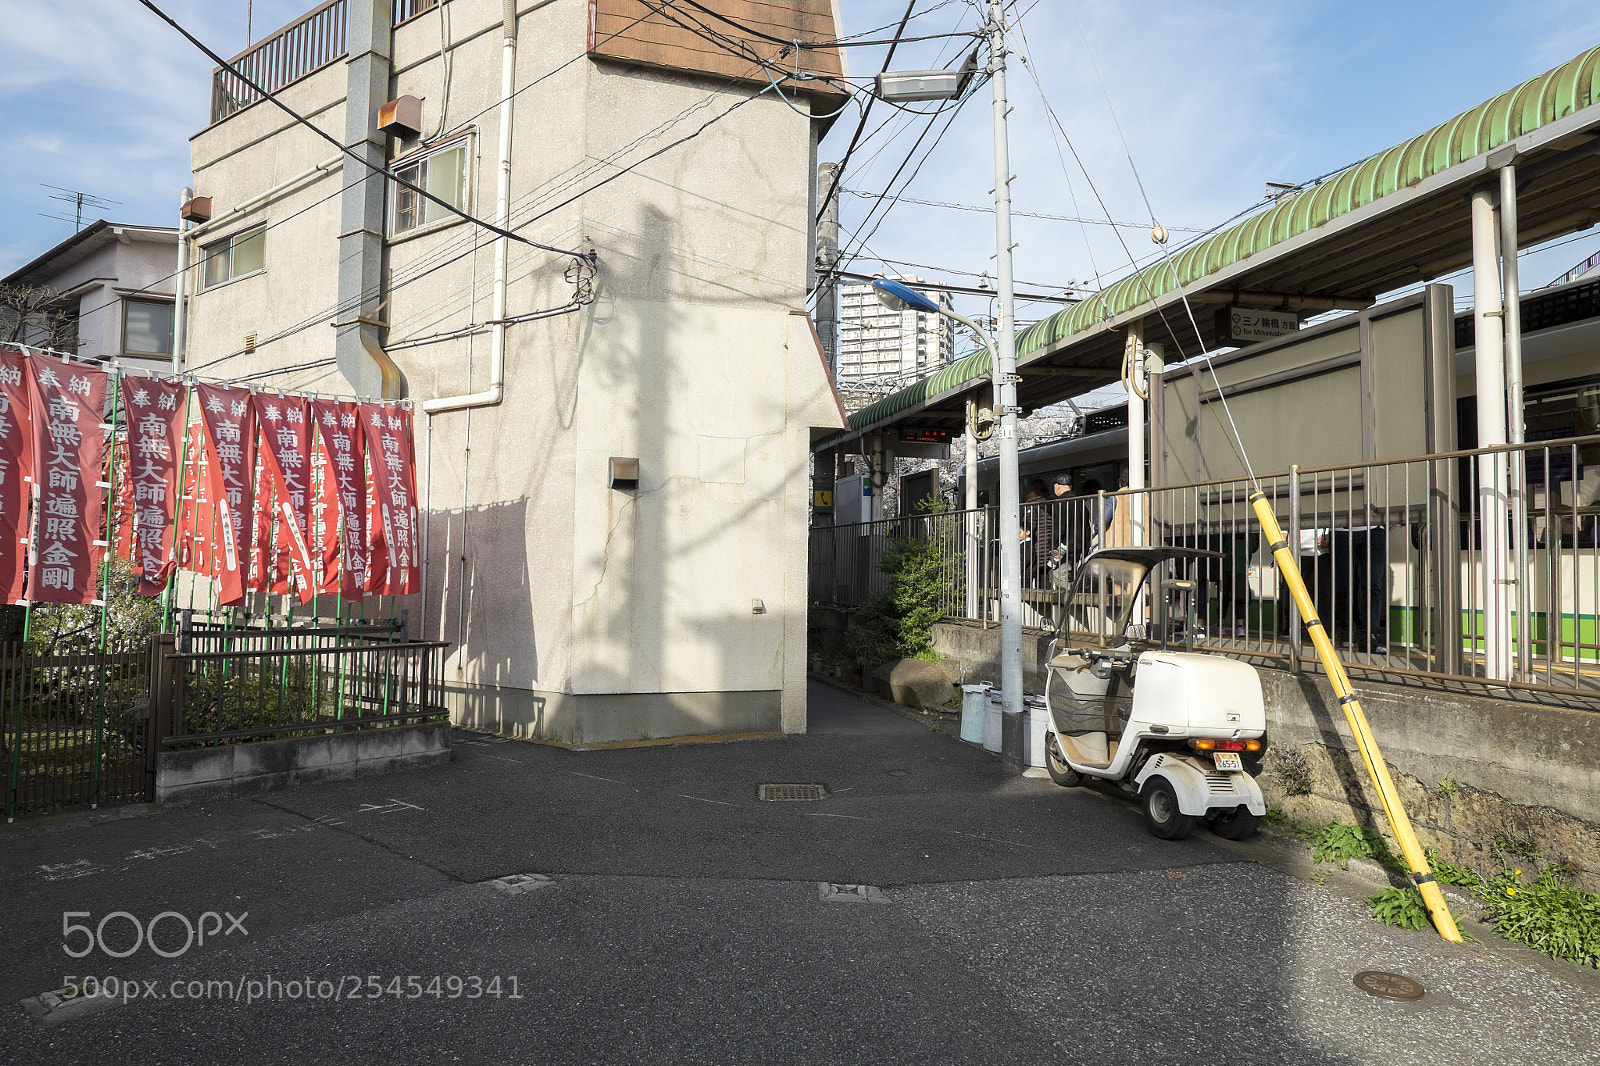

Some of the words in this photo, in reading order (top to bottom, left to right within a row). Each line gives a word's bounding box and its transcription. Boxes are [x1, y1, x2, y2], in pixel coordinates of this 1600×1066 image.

[1254, 329, 1290, 337] Minowab
[38, 366, 91, 397] 奉納
[131, 387, 176, 412] 奉納
[205, 393, 248, 418] 奉納
[265, 404, 303, 424] 奉納
[322, 409, 356, 429] 奉納
[371, 411, 403, 432] 奉納
[41, 394, 82, 591] 南無大師遍照金剛
[133, 412, 169, 586] 南無大師遍照金
